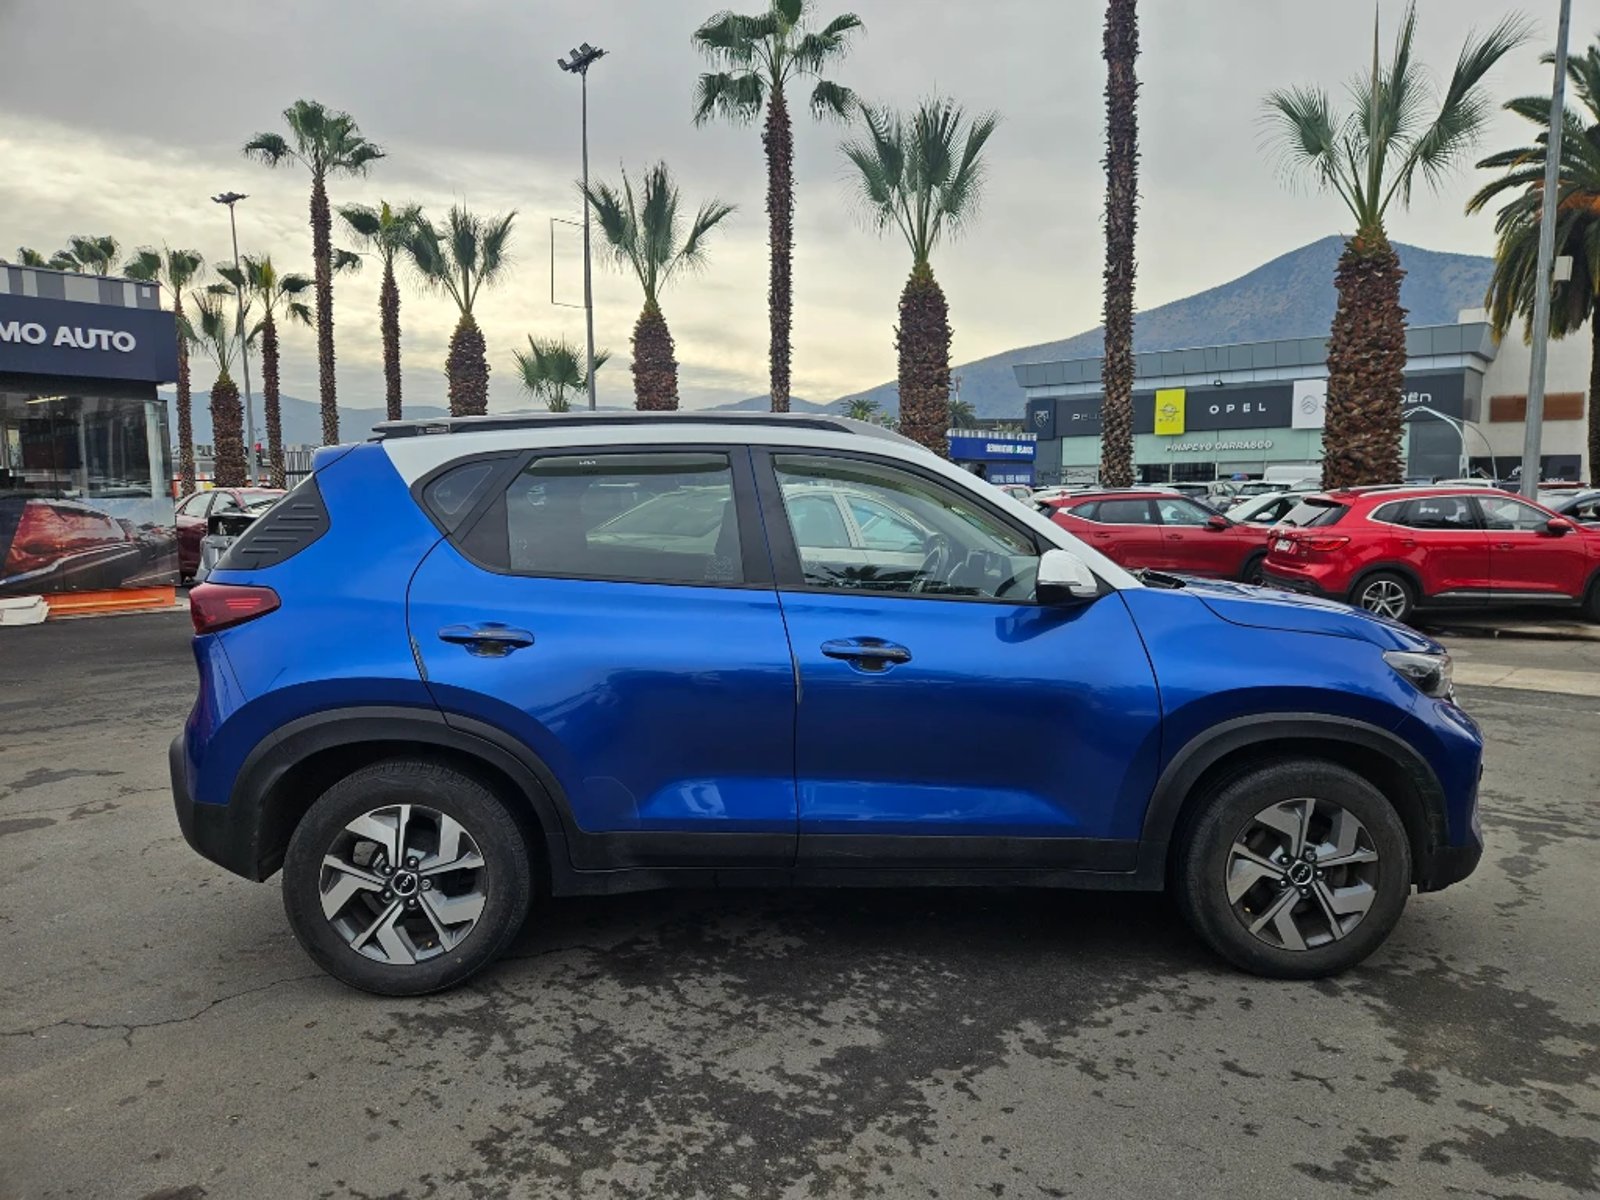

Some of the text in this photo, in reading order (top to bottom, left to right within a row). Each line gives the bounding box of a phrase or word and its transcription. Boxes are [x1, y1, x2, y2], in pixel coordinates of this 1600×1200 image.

[53, 326, 136, 352] AUTO
[1209, 402, 1266, 415] OPEL
[1165, 439, 1273, 453] POMPEYO CARRASCO
